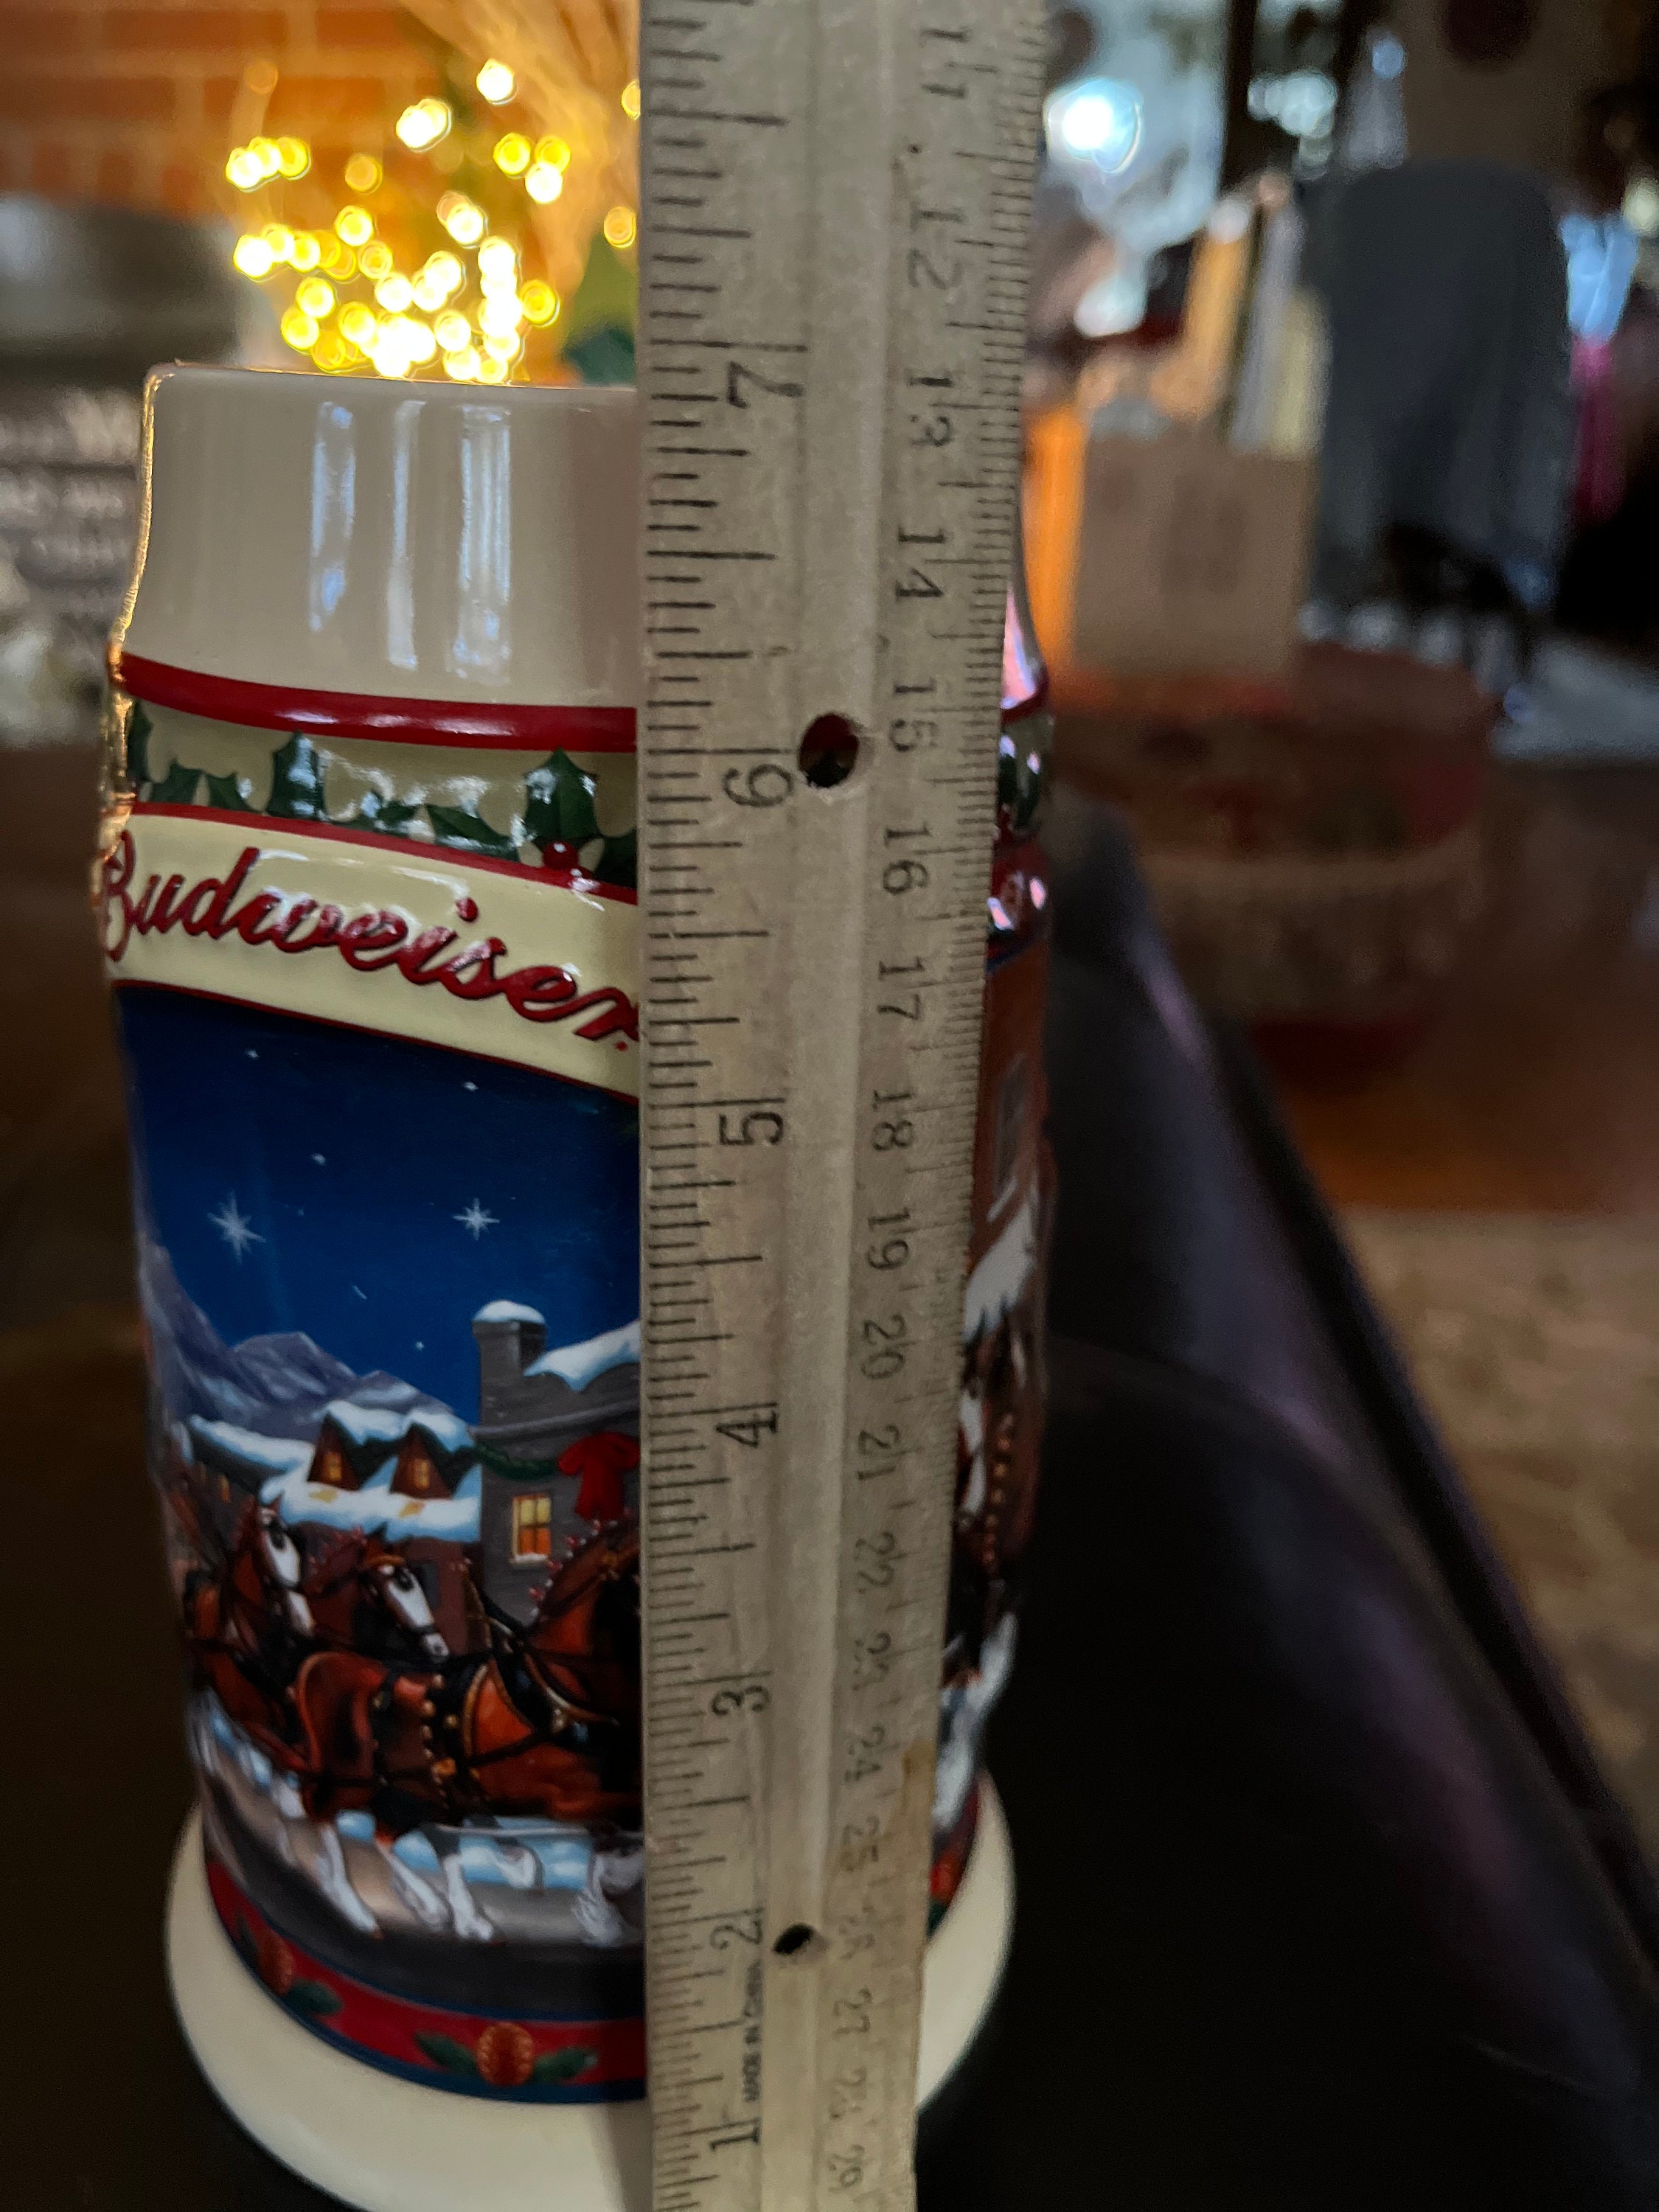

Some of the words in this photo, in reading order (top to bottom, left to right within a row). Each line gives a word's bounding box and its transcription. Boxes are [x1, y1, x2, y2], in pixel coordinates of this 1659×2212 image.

[726, 361, 805, 408] 7
[895, 526, 945, 602] 14
[889, 680, 941, 752] 15
[721, 762, 795, 808] 6
[883, 820, 932, 895] 16
[101, 829, 639, 1041] Budweiser
[876, 956, 926, 1020] 17
[717, 1109, 786, 1147] 5
[872, 1088, 914, 1152] 18
[866, 1206, 911, 1270] 19
[860, 1312, 908, 1380] 20
[715, 1407, 779, 1448] 4
[855, 1423, 901, 1481] 21
[854, 1529, 896, 1595] 22
[710, 1684, 771, 1717] 3
[844, 1725, 885, 1783] 24
[709, 1914, 764, 1950] 2
[709, 2125, 761, 2152] 1
